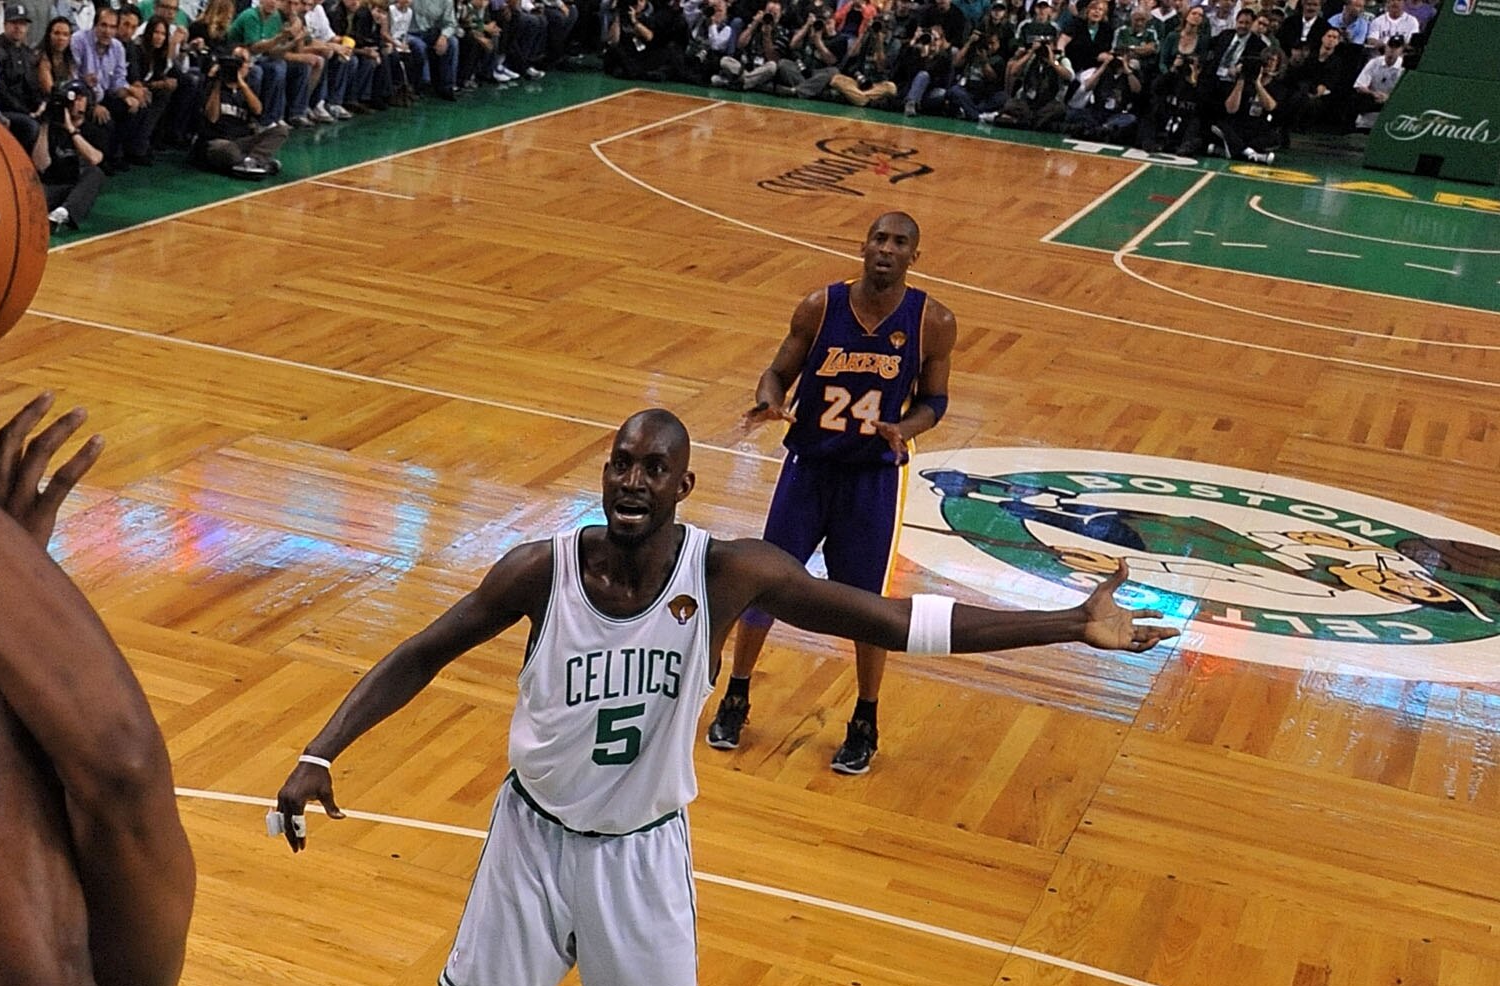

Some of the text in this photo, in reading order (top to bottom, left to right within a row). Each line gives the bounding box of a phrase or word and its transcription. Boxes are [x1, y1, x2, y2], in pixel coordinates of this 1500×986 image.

[1402, 109, 1496, 144] Finals
[816, 347, 902, 380] LAKERS
[819, 385, 883, 435] 24
[1065, 474, 1397, 539] BOSTON
[565, 648, 682, 707] CELTICS
[591, 703, 646, 766] 5
